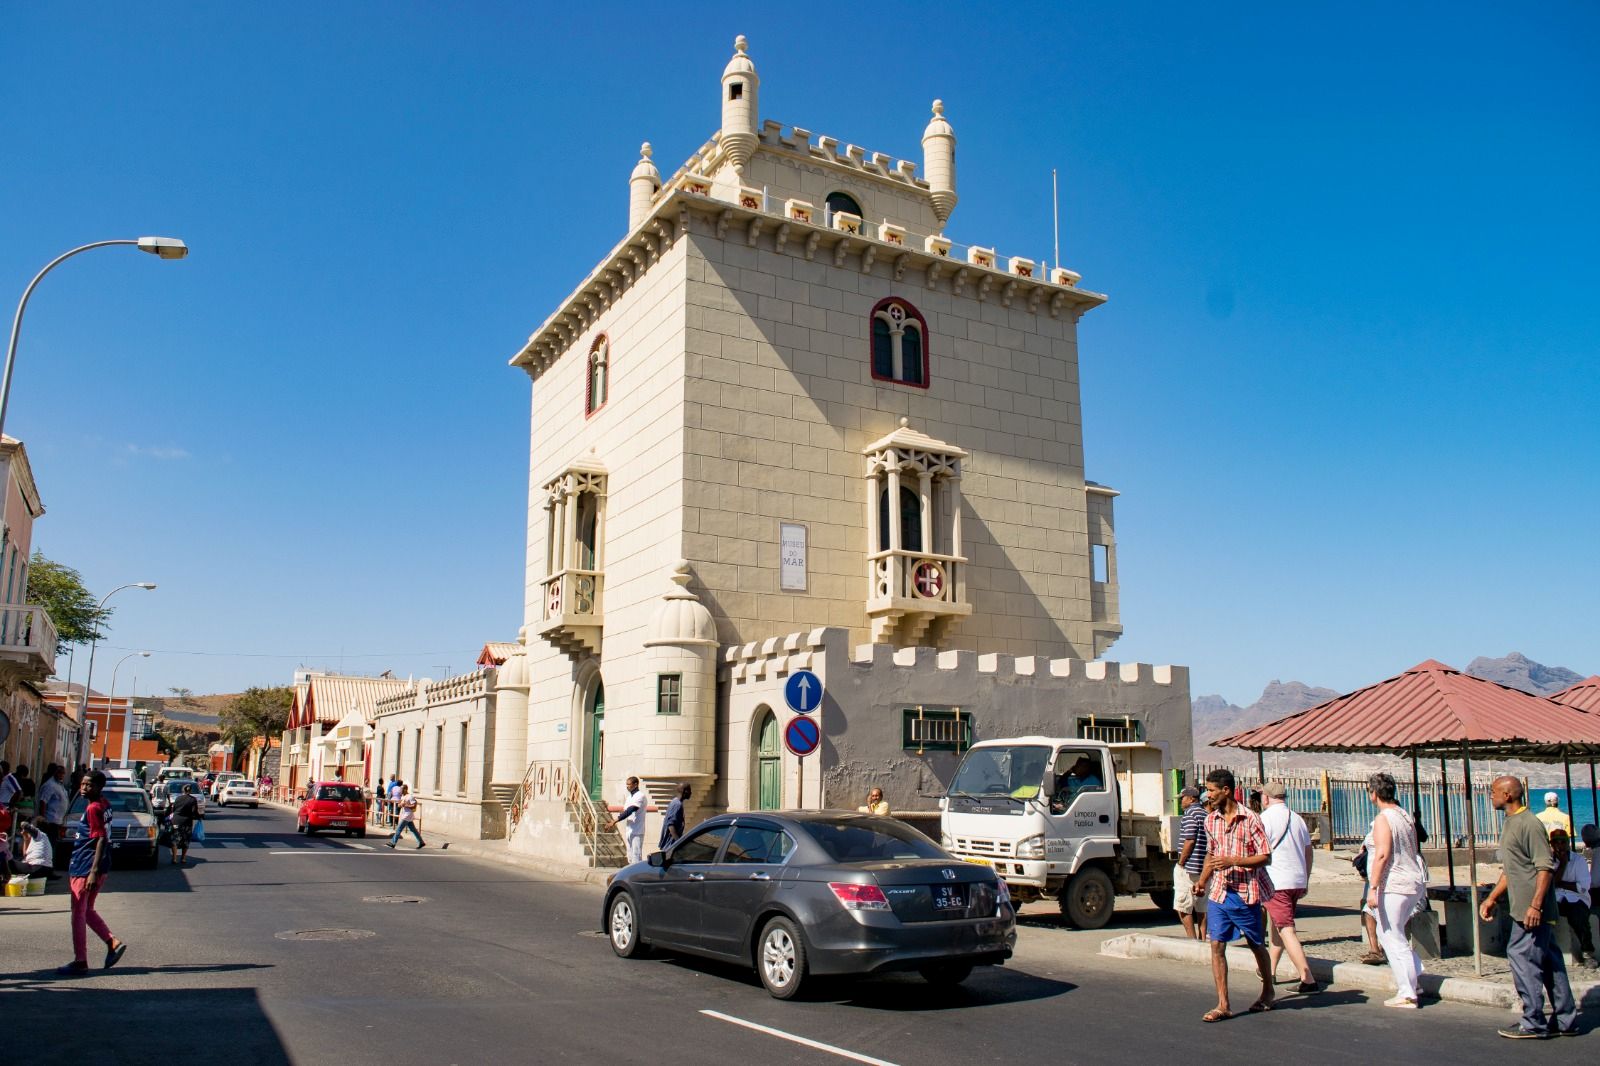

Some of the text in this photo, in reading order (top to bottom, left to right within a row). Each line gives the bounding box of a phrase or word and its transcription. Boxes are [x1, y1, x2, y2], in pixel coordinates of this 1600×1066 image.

[783, 557, 804, 567] MAR
[1074, 811, 1097, 819] Limpeza
[941, 886, 953, 896] SV
[936, 897, 962, 907] 35-EC
